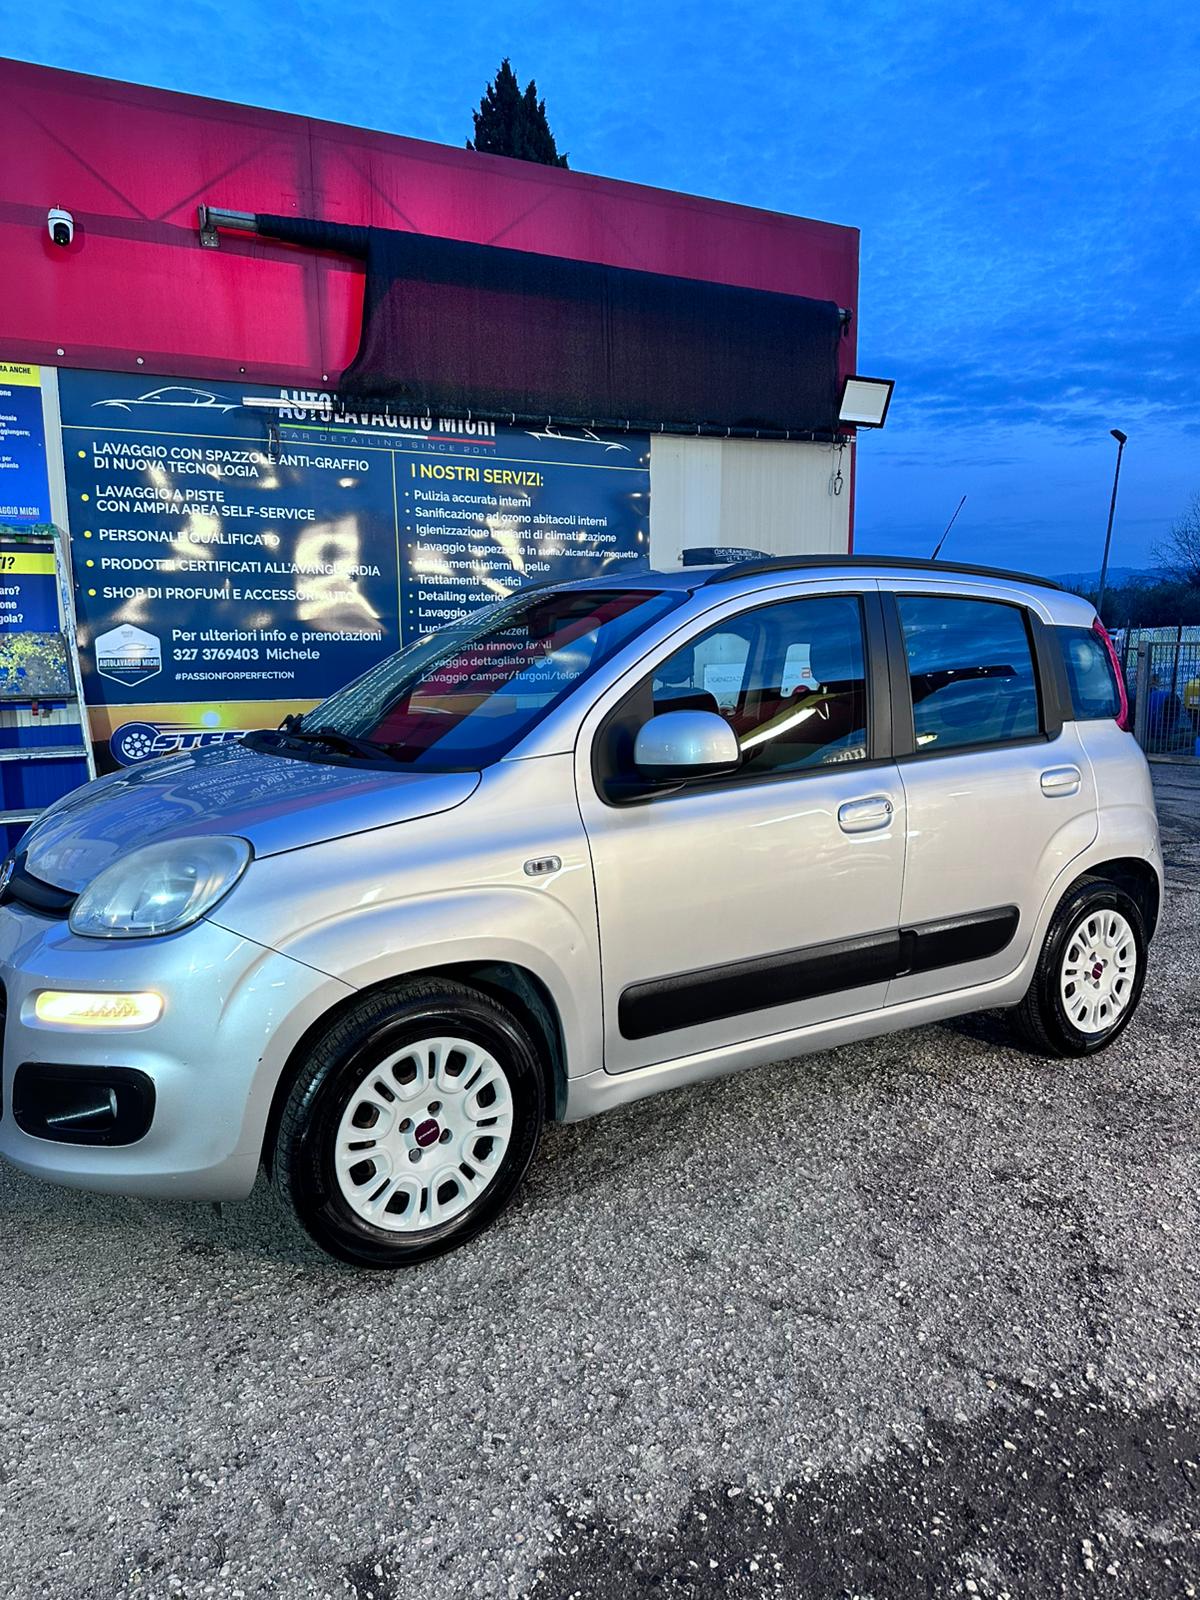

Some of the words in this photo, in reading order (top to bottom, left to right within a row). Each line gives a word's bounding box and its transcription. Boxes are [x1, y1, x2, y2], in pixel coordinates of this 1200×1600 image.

[9, 365, 32, 375] ANCHE
[279, 430, 311, 441] CAR
[319, 434, 403, 449] DETAILING
[411, 441, 456, 453] SINCE
[464, 446, 497, 456] 2011
[92, 441, 167, 459] LAVAGGIO
[170, 446, 204, 461] CON
[205, 448, 276, 466] SPAZZOLE
[279, 453, 370, 472] ANTI-GRAFFIO
[94, 456, 110, 469] DI
[113, 457, 166, 473] NUOVA
[168, 460, 259, 478] TECNOLOGIA
[411, 463, 416, 477] I
[420, 464, 480, 482] NOSTRI
[483, 469, 544, 487] SERVIZI:
[95, 484, 169, 501] LAVAGGIO
[172, 489, 183, 501] A
[185, 489, 225, 503] PISTE
[414, 490, 450, 502] Pulizia
[452, 493, 497, 505] accurata
[499, 495, 531, 507] interni
[19, 506, 40, 516] MICRI
[96, 499, 131, 513] CON
[133, 501, 180, 515] AMPIA
[181, 502, 219, 516] AREA
[221, 504, 316, 521] SELF-SERVICE
[415, 507, 484, 521] Sanificazione
[486, 511, 499, 521] ad
[501, 514, 531, 526] ozono
[533, 513, 576, 526] abitacoli
[577, 515, 607, 527] interni
[99, 528, 186, 545] PERSONALE
[189, 531, 280, 547] QUALIFICATO
[416, 524, 489, 538] Igienizzazione
[491, 527, 531, 539] ianti
[533, 529, 543, 540] di
[545, 530, 617, 543] climatizzazione
[417, 541, 465, 555] Lavaggio
[467, 543, 525, 557] tappezze
[527, 546, 537, 556] in
[538, 548, 639, 560] stoffa/alcantara/moquette
[179, 560, 261, 573] CERTIFICATI
[480, 560, 512, 571] interni
[525, 561, 550, 573] pelle
[418, 574, 479, 586] Trattamenti
[481, 576, 522, 587] specifici
[103, 586, 144, 600] SHOP
[147, 587, 162, 600] DI
[165, 587, 229, 600] PROFUMI
[233, 588, 241, 600] E
[418, 591, 466, 604] Detailing
[468, 592, 505, 602] exterio
[418, 607, 467, 620] Lavaggio
[172, 629, 197, 642] Per
[200, 629, 257, 642] ulteriori
[260, 629, 287, 642] info
[290, 632, 299, 642] e
[301, 629, 382, 645] prenotazioni
[486, 640, 524, 650] rinnovo
[173, 648, 197, 661] 327
[202, 648, 259, 661] 3769403
[266, 648, 320, 661] Michele
[470, 655, 525, 669] dettagliato
[530, 655, 553, 665] mto
[175, 671, 295, 681] #PASSIONFORPERFECTION
[422, 672, 468, 684] Lavaggio
